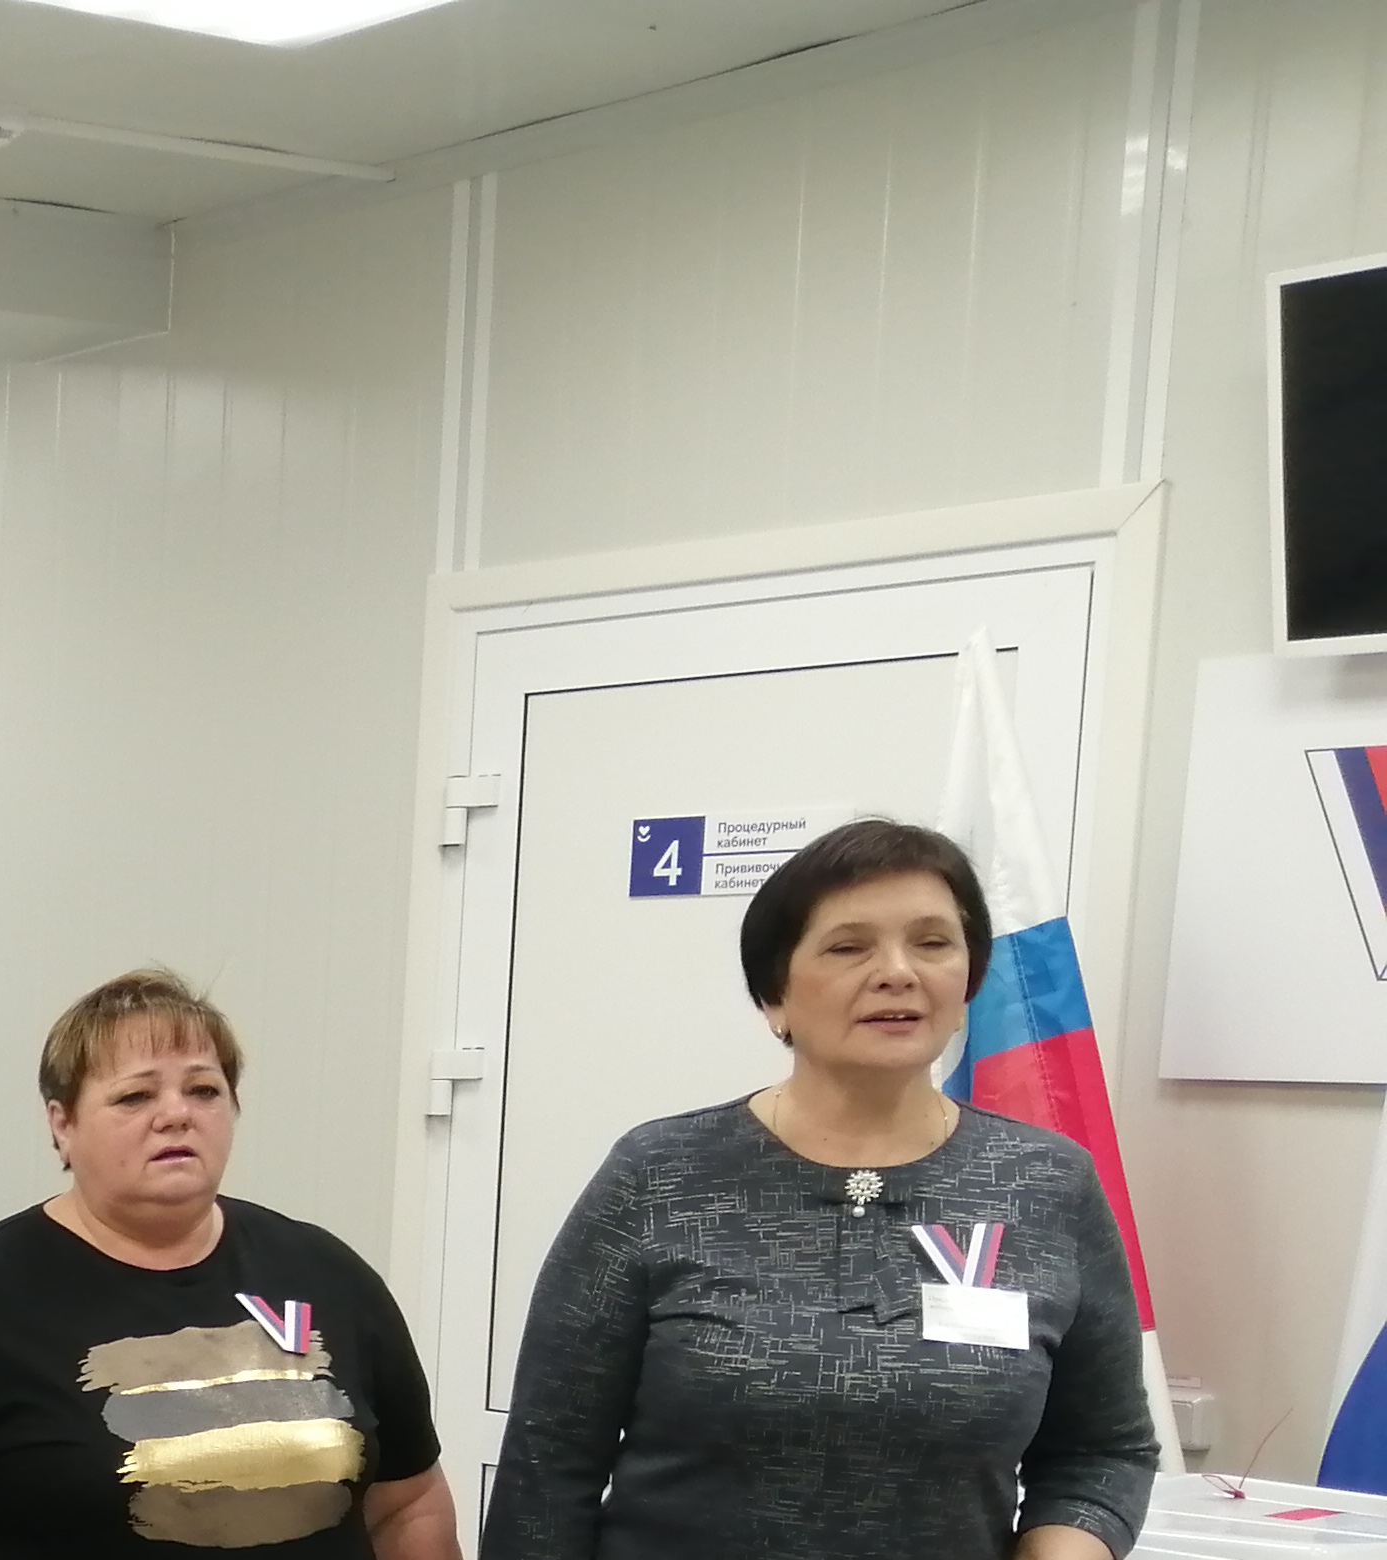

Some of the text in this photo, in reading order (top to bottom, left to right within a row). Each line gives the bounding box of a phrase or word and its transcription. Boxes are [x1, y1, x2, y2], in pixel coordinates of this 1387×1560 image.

[717, 818, 807, 834] Процедурный
[716, 837, 768, 849] кабинет
[652, 839, 683, 886] 4
[713, 877, 765, 890] кабинет
